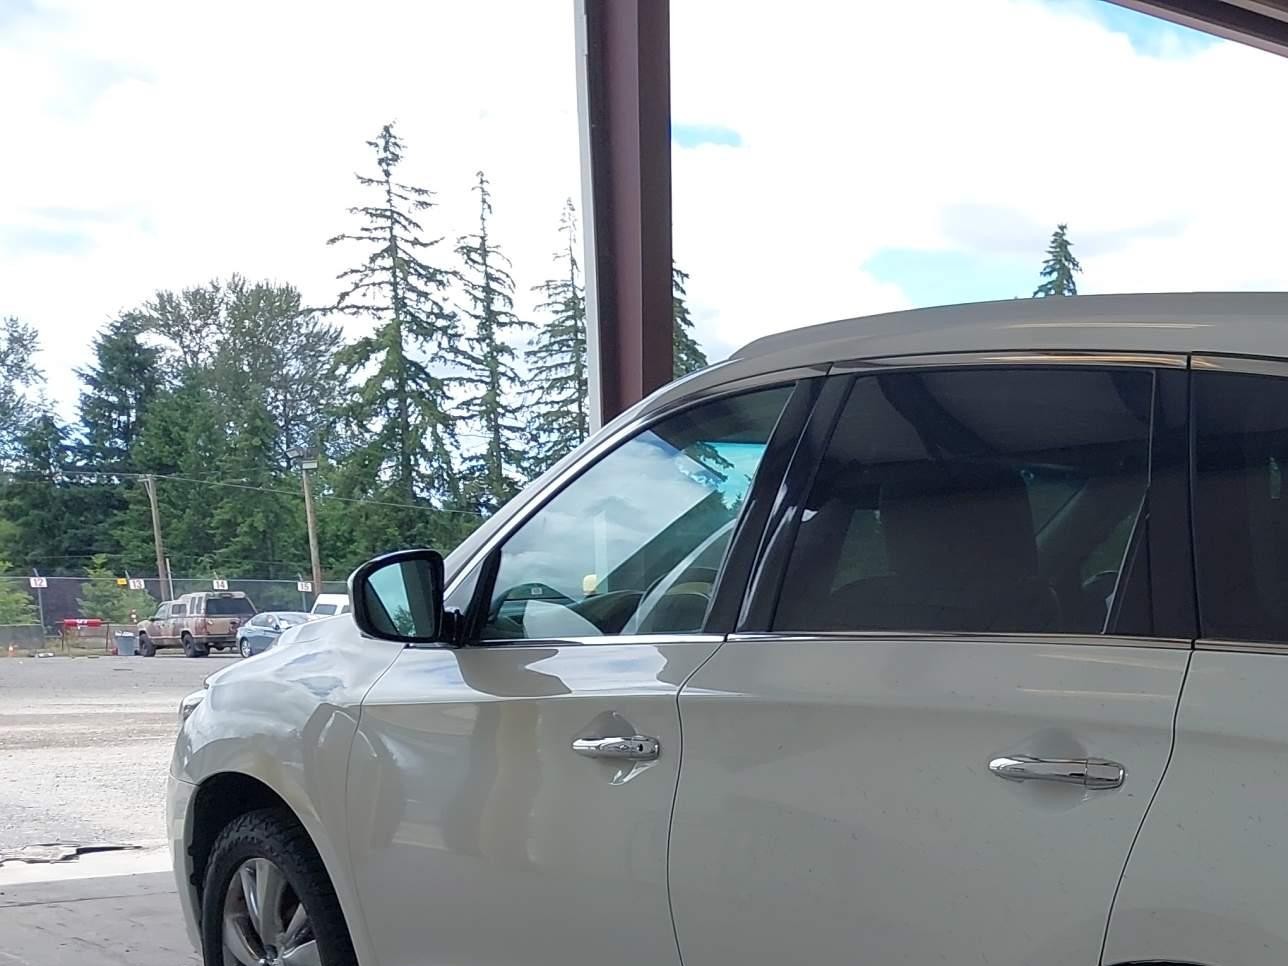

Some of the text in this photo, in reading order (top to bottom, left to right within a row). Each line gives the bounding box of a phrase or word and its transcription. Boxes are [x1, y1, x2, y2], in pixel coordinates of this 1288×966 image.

[33, 578, 44, 587] 12
[132, 580, 143, 589] 13
[215, 581, 226, 590] 14
[300, 582, 310, 591] 15
